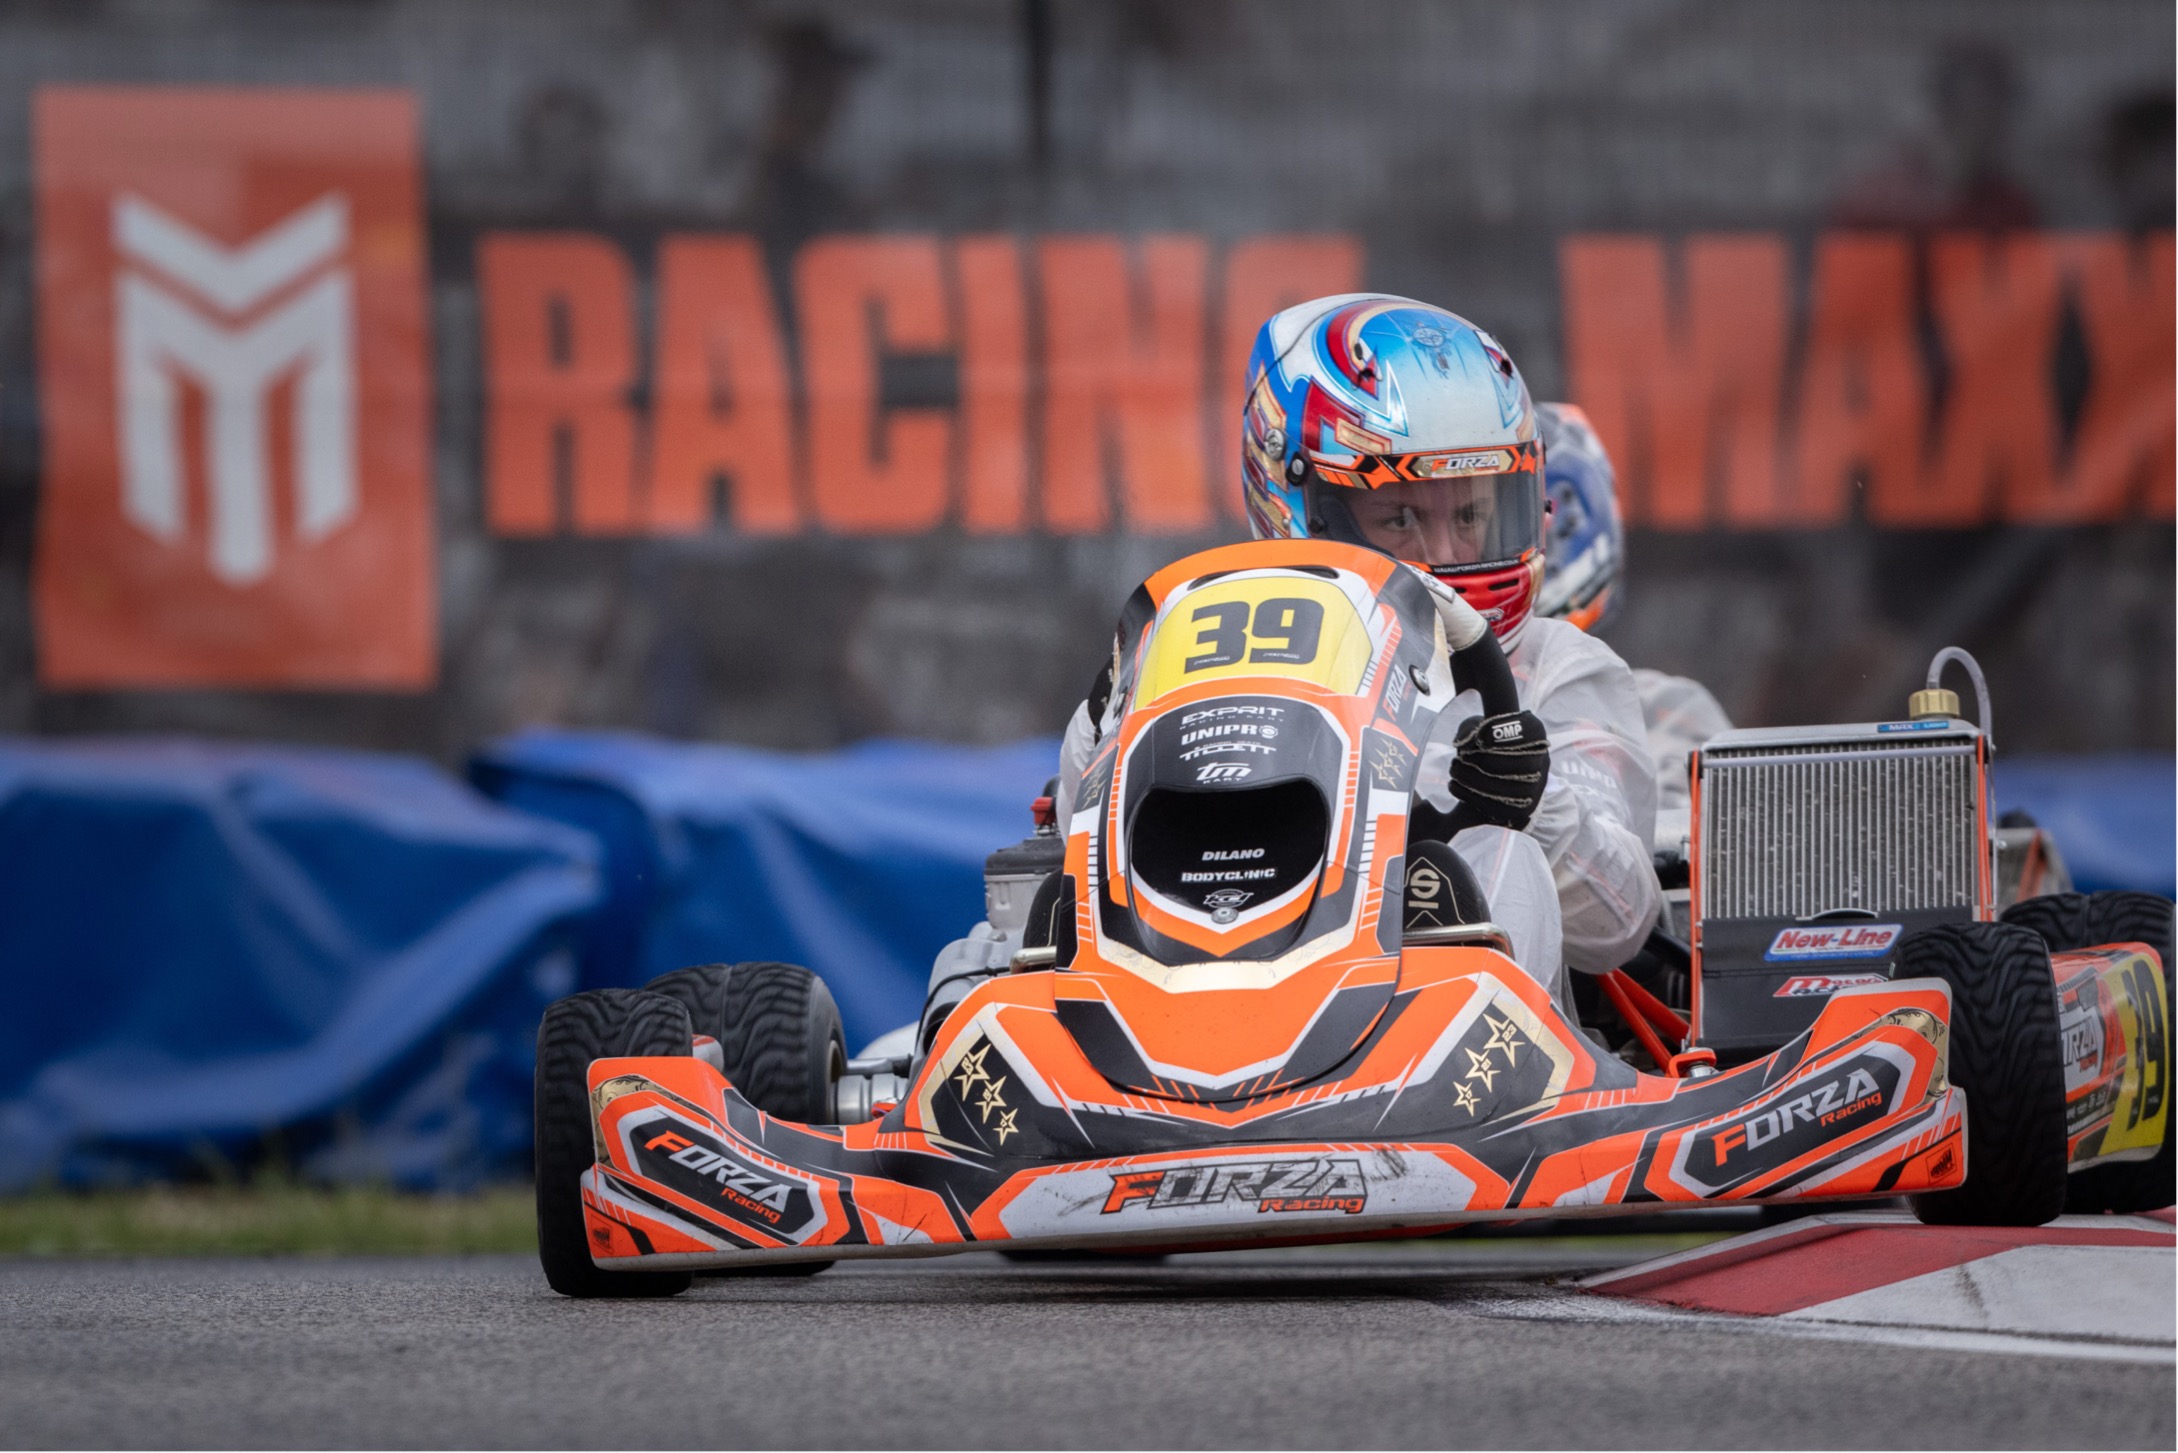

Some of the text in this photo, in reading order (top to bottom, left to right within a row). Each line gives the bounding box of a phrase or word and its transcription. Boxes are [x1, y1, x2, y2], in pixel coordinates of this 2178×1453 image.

[1431, 455, 1499, 472] FORZA
[1184, 598, 1325, 674] 39
[1181, 706, 1285, 725] EXPRIT
[1492, 723, 1523, 740] OMP
[1202, 848, 1265, 861] DILANO
[1181, 868, 1275, 882] BODYCLINIC
[1776, 928, 1893, 949] New-Line
[1711, 1067, 1881, 1167] FORZA
[1820, 1092, 1883, 1128] Racing
[644, 1130, 793, 1213] FORZA
[1101, 1159, 1367, 1214] FORZA
[721, 1187, 782, 1224] Racing
[1258, 1194, 1367, 1214] Racing
